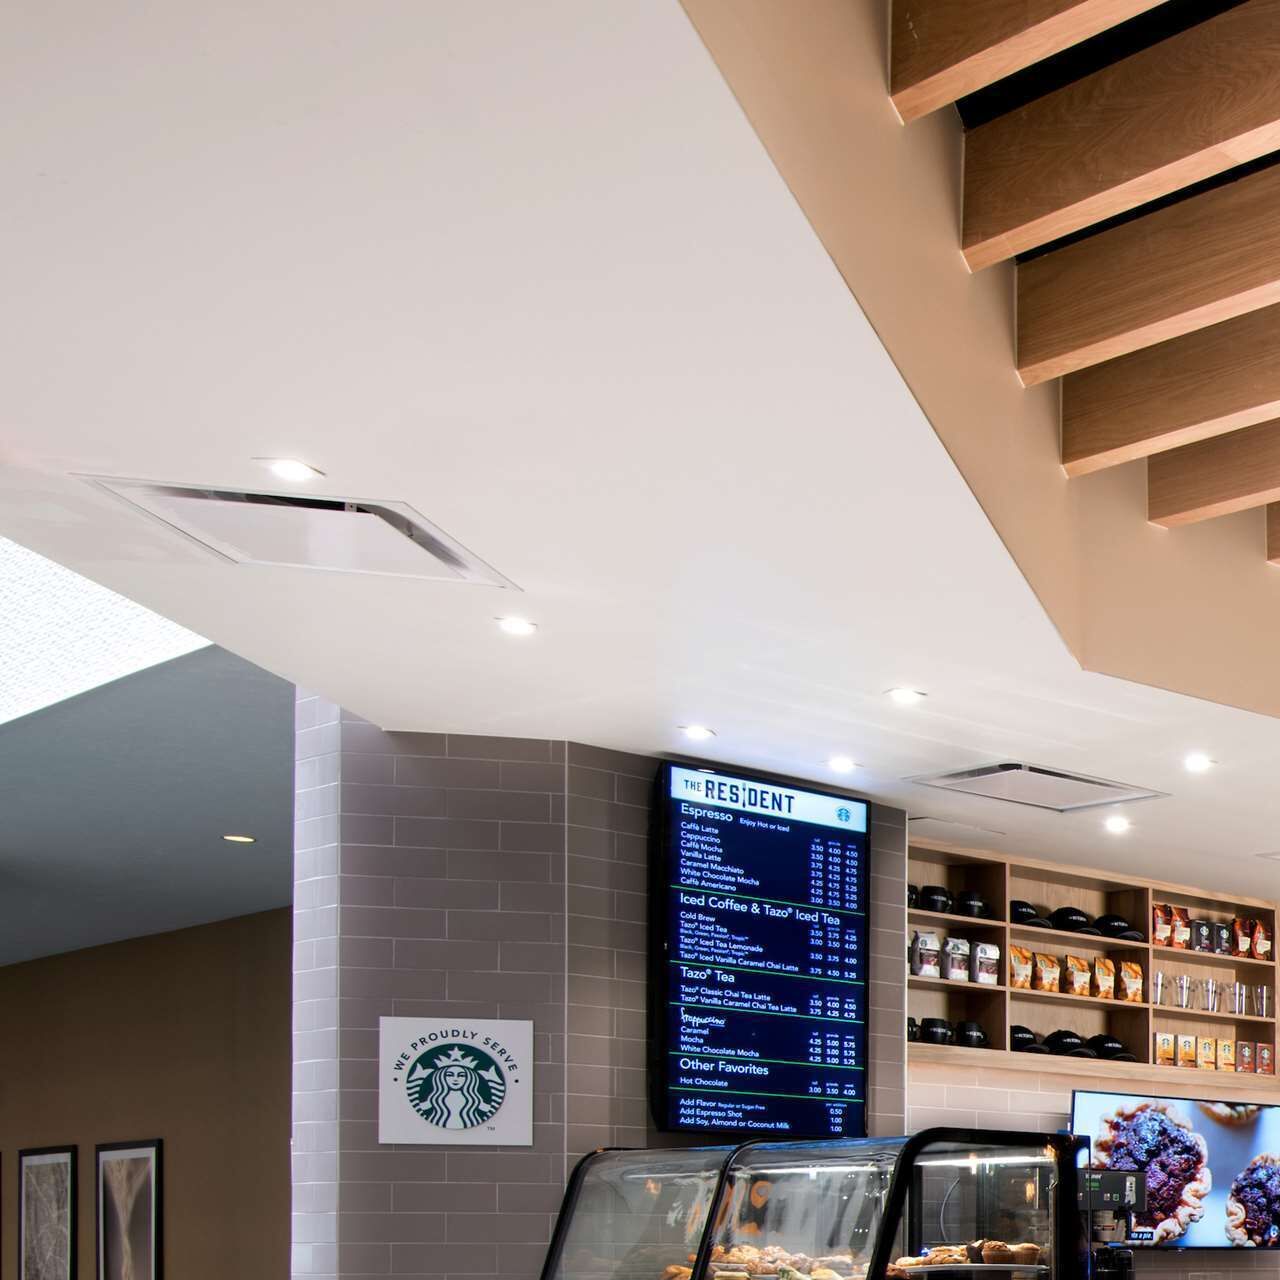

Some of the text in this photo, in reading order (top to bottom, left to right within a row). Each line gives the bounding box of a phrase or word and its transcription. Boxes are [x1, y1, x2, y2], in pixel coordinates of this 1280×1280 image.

[684, 779, 795, 813] THE RESIDENT
[681, 802, 733, 822] Espresso
[680, 892, 705, 906] Iced
[708, 897, 748, 912] Coffee
[751, 903, 760, 913] &
[796, 909, 819, 922] Iced
[822, 913, 840, 925] Tea
[714, 970, 735, 983] Tea
[394, 1029, 518, 1071] WE PROUDLY SERVE
[680, 1058, 768, 1075] Other Favorites
